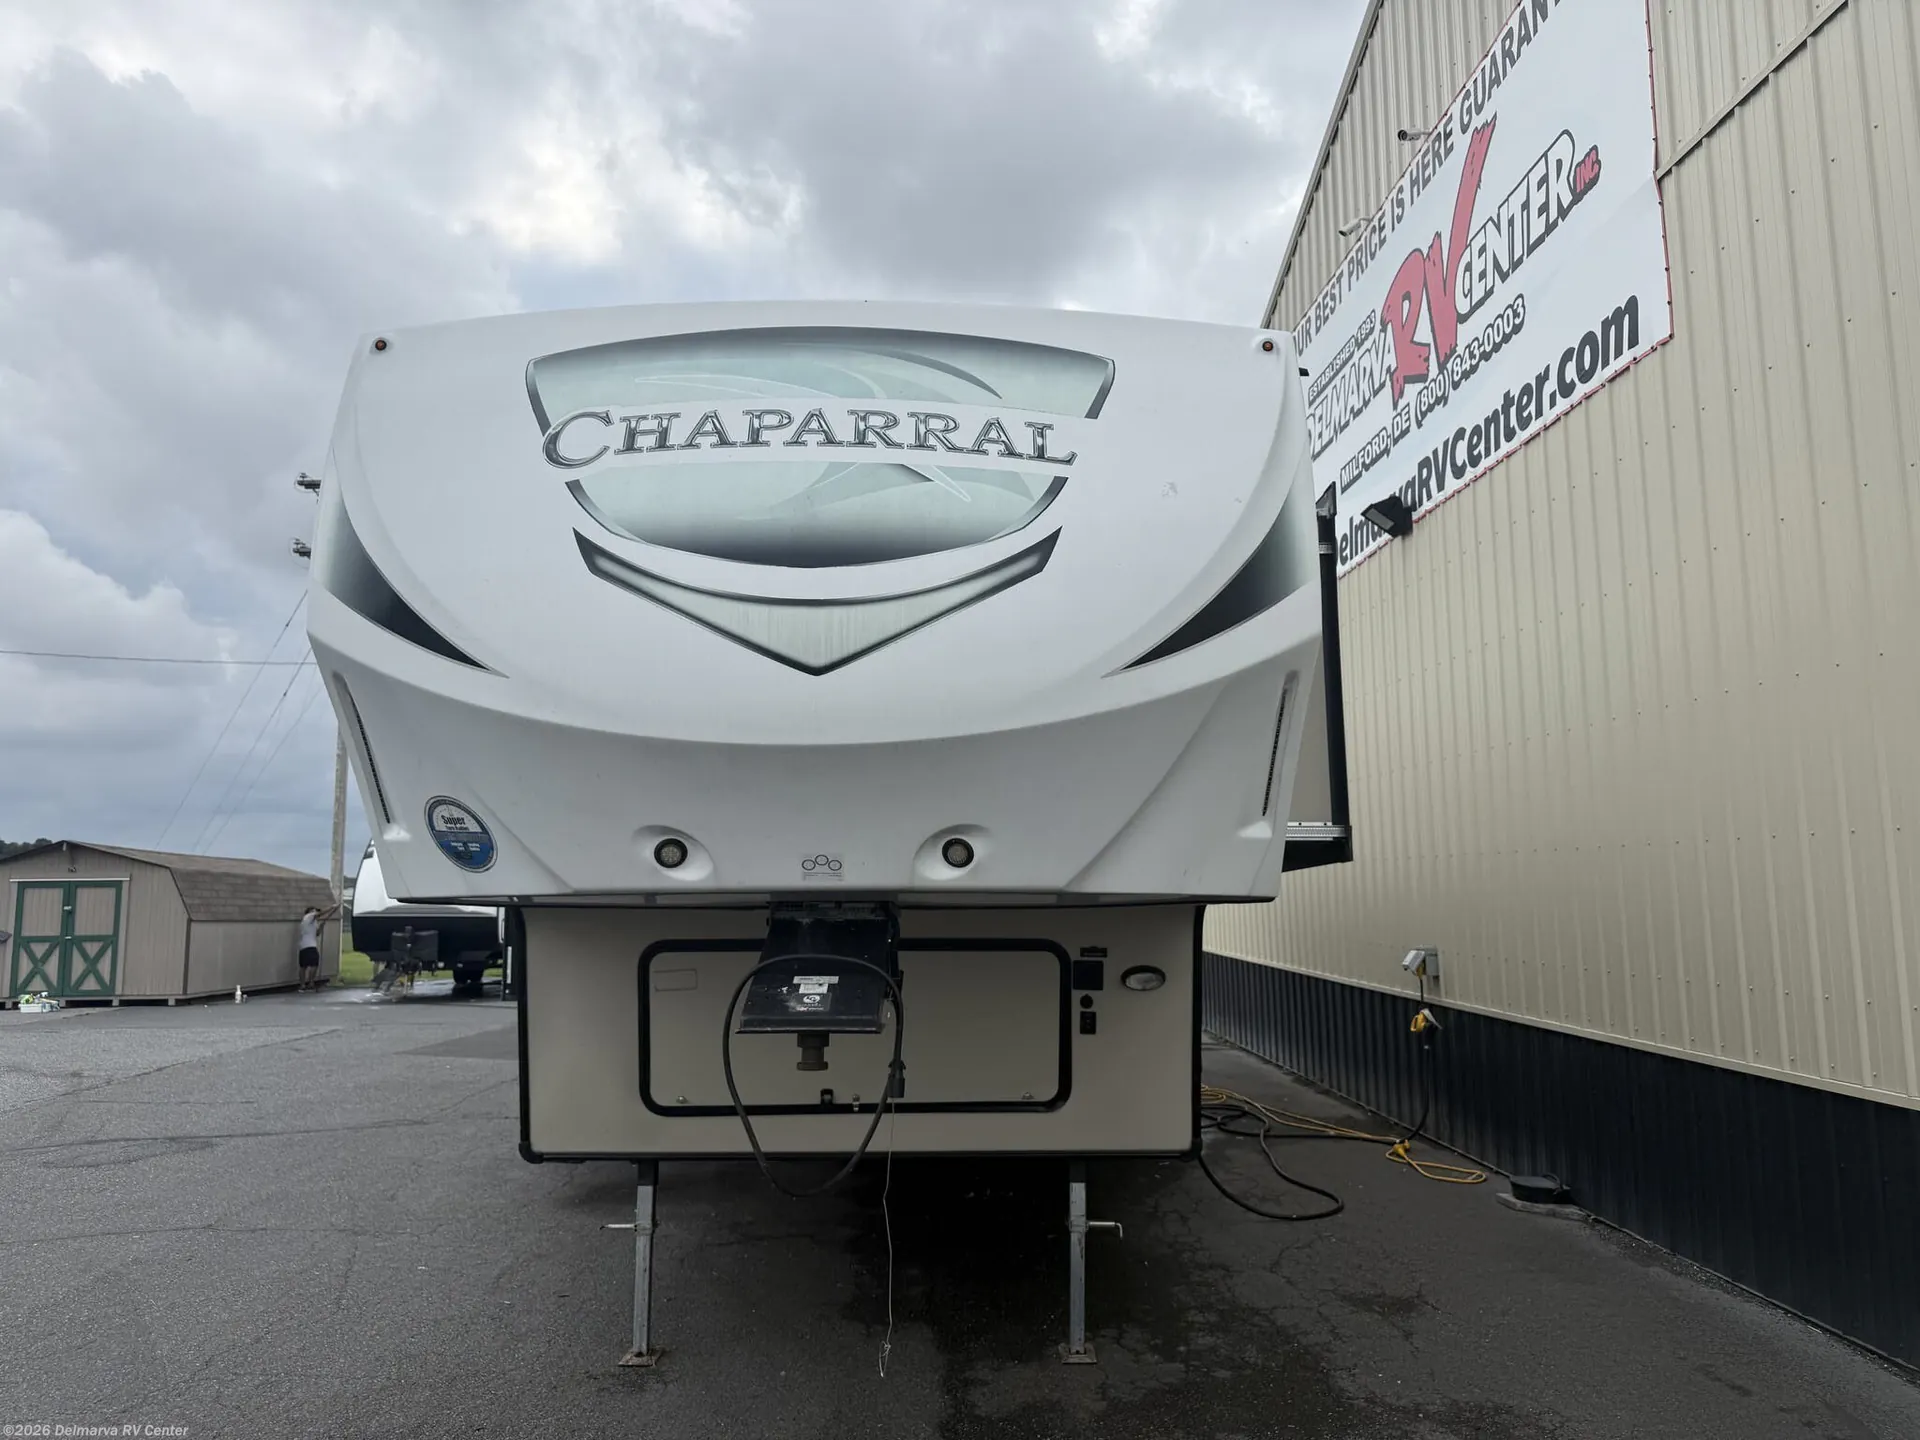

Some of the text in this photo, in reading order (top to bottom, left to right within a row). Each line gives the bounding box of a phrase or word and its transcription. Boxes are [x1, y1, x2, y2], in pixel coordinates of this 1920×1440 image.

[1294, 0, 1560, 357] UR BEST PRICE IS HERE GUARAN
[1381, 112, 1497, 411] RV
[1454, 129, 1576, 324] CENTER
[542, 409, 1078, 470] CHAPARRAL
[1308, 308, 1377, 408] ESTABLISHED 1993
[1336, 295, 1640, 567] elmaRVCenter.com
[1340, 293, 1526, 495] MILFORD, DE (800) 843-0003
